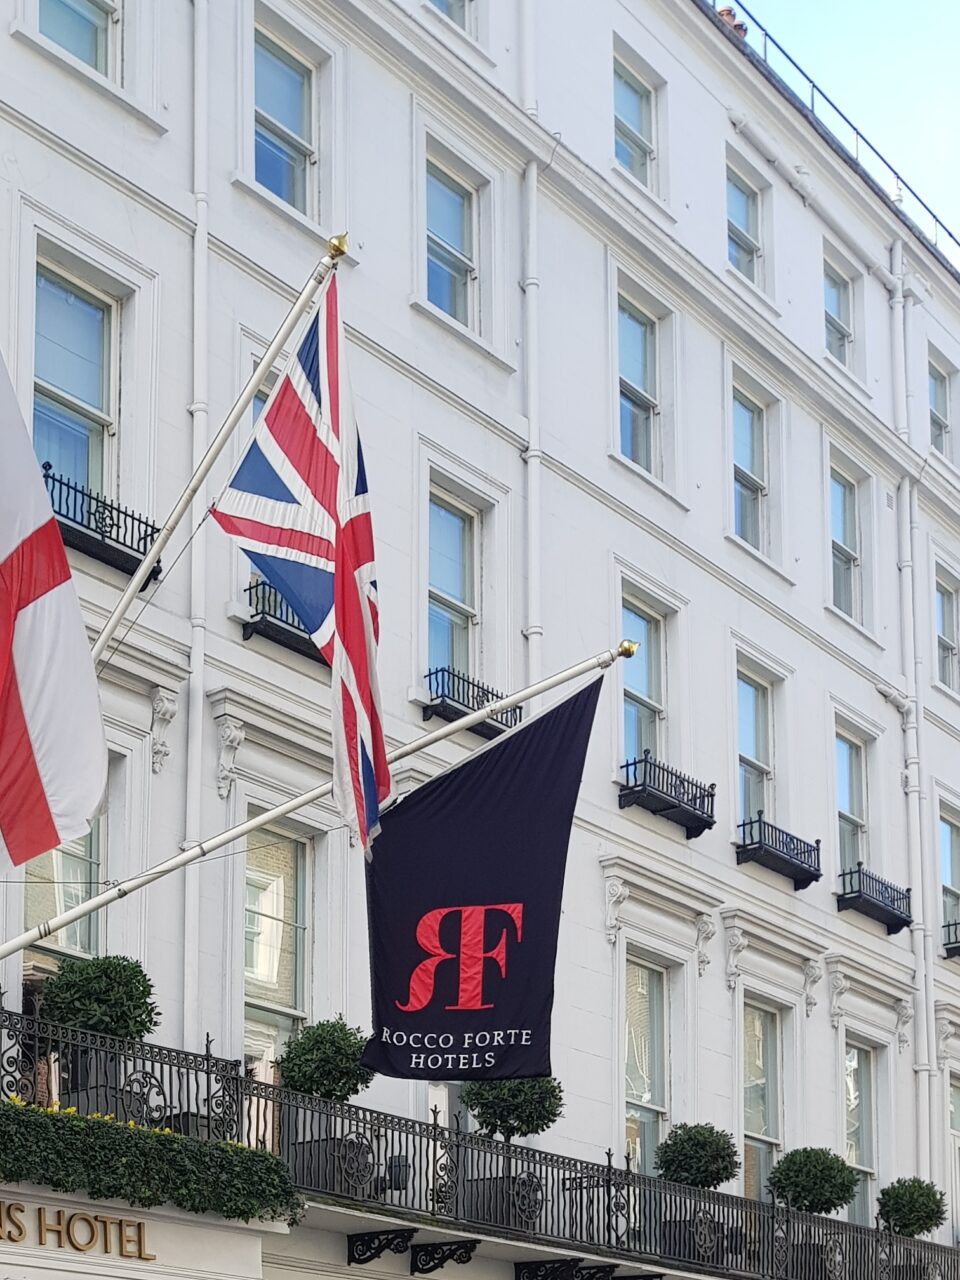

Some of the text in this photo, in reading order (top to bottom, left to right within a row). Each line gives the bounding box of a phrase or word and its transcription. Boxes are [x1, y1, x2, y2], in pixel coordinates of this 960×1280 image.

[381, 1026, 533, 1049] ROCCO FORTE
[409, 1052, 496, 1070] HOTELS
[38, 1206, 157, 1261] HOTEL
